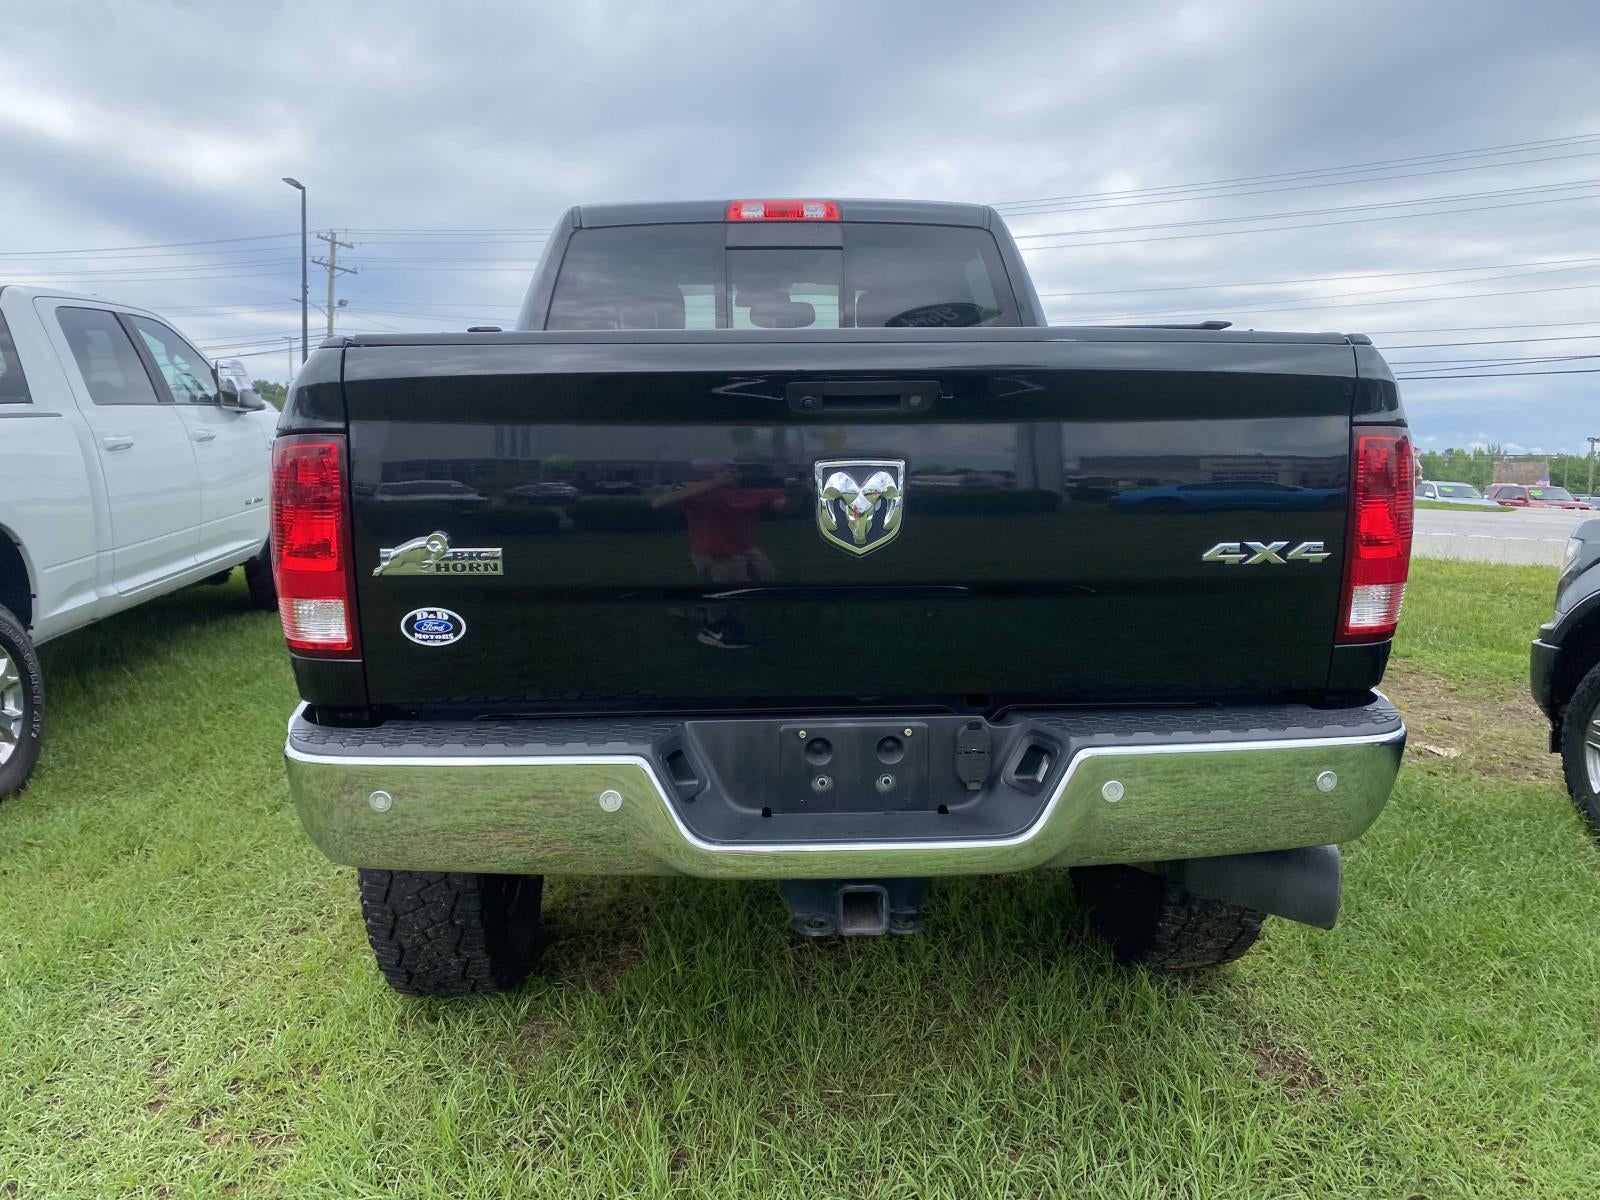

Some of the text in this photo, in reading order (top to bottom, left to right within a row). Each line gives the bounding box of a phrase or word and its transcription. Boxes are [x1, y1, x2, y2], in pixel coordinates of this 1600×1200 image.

[435, 562, 499, 573] HORN
[416, 611, 449, 621] D&D
[421, 621, 446, 632] Ford
